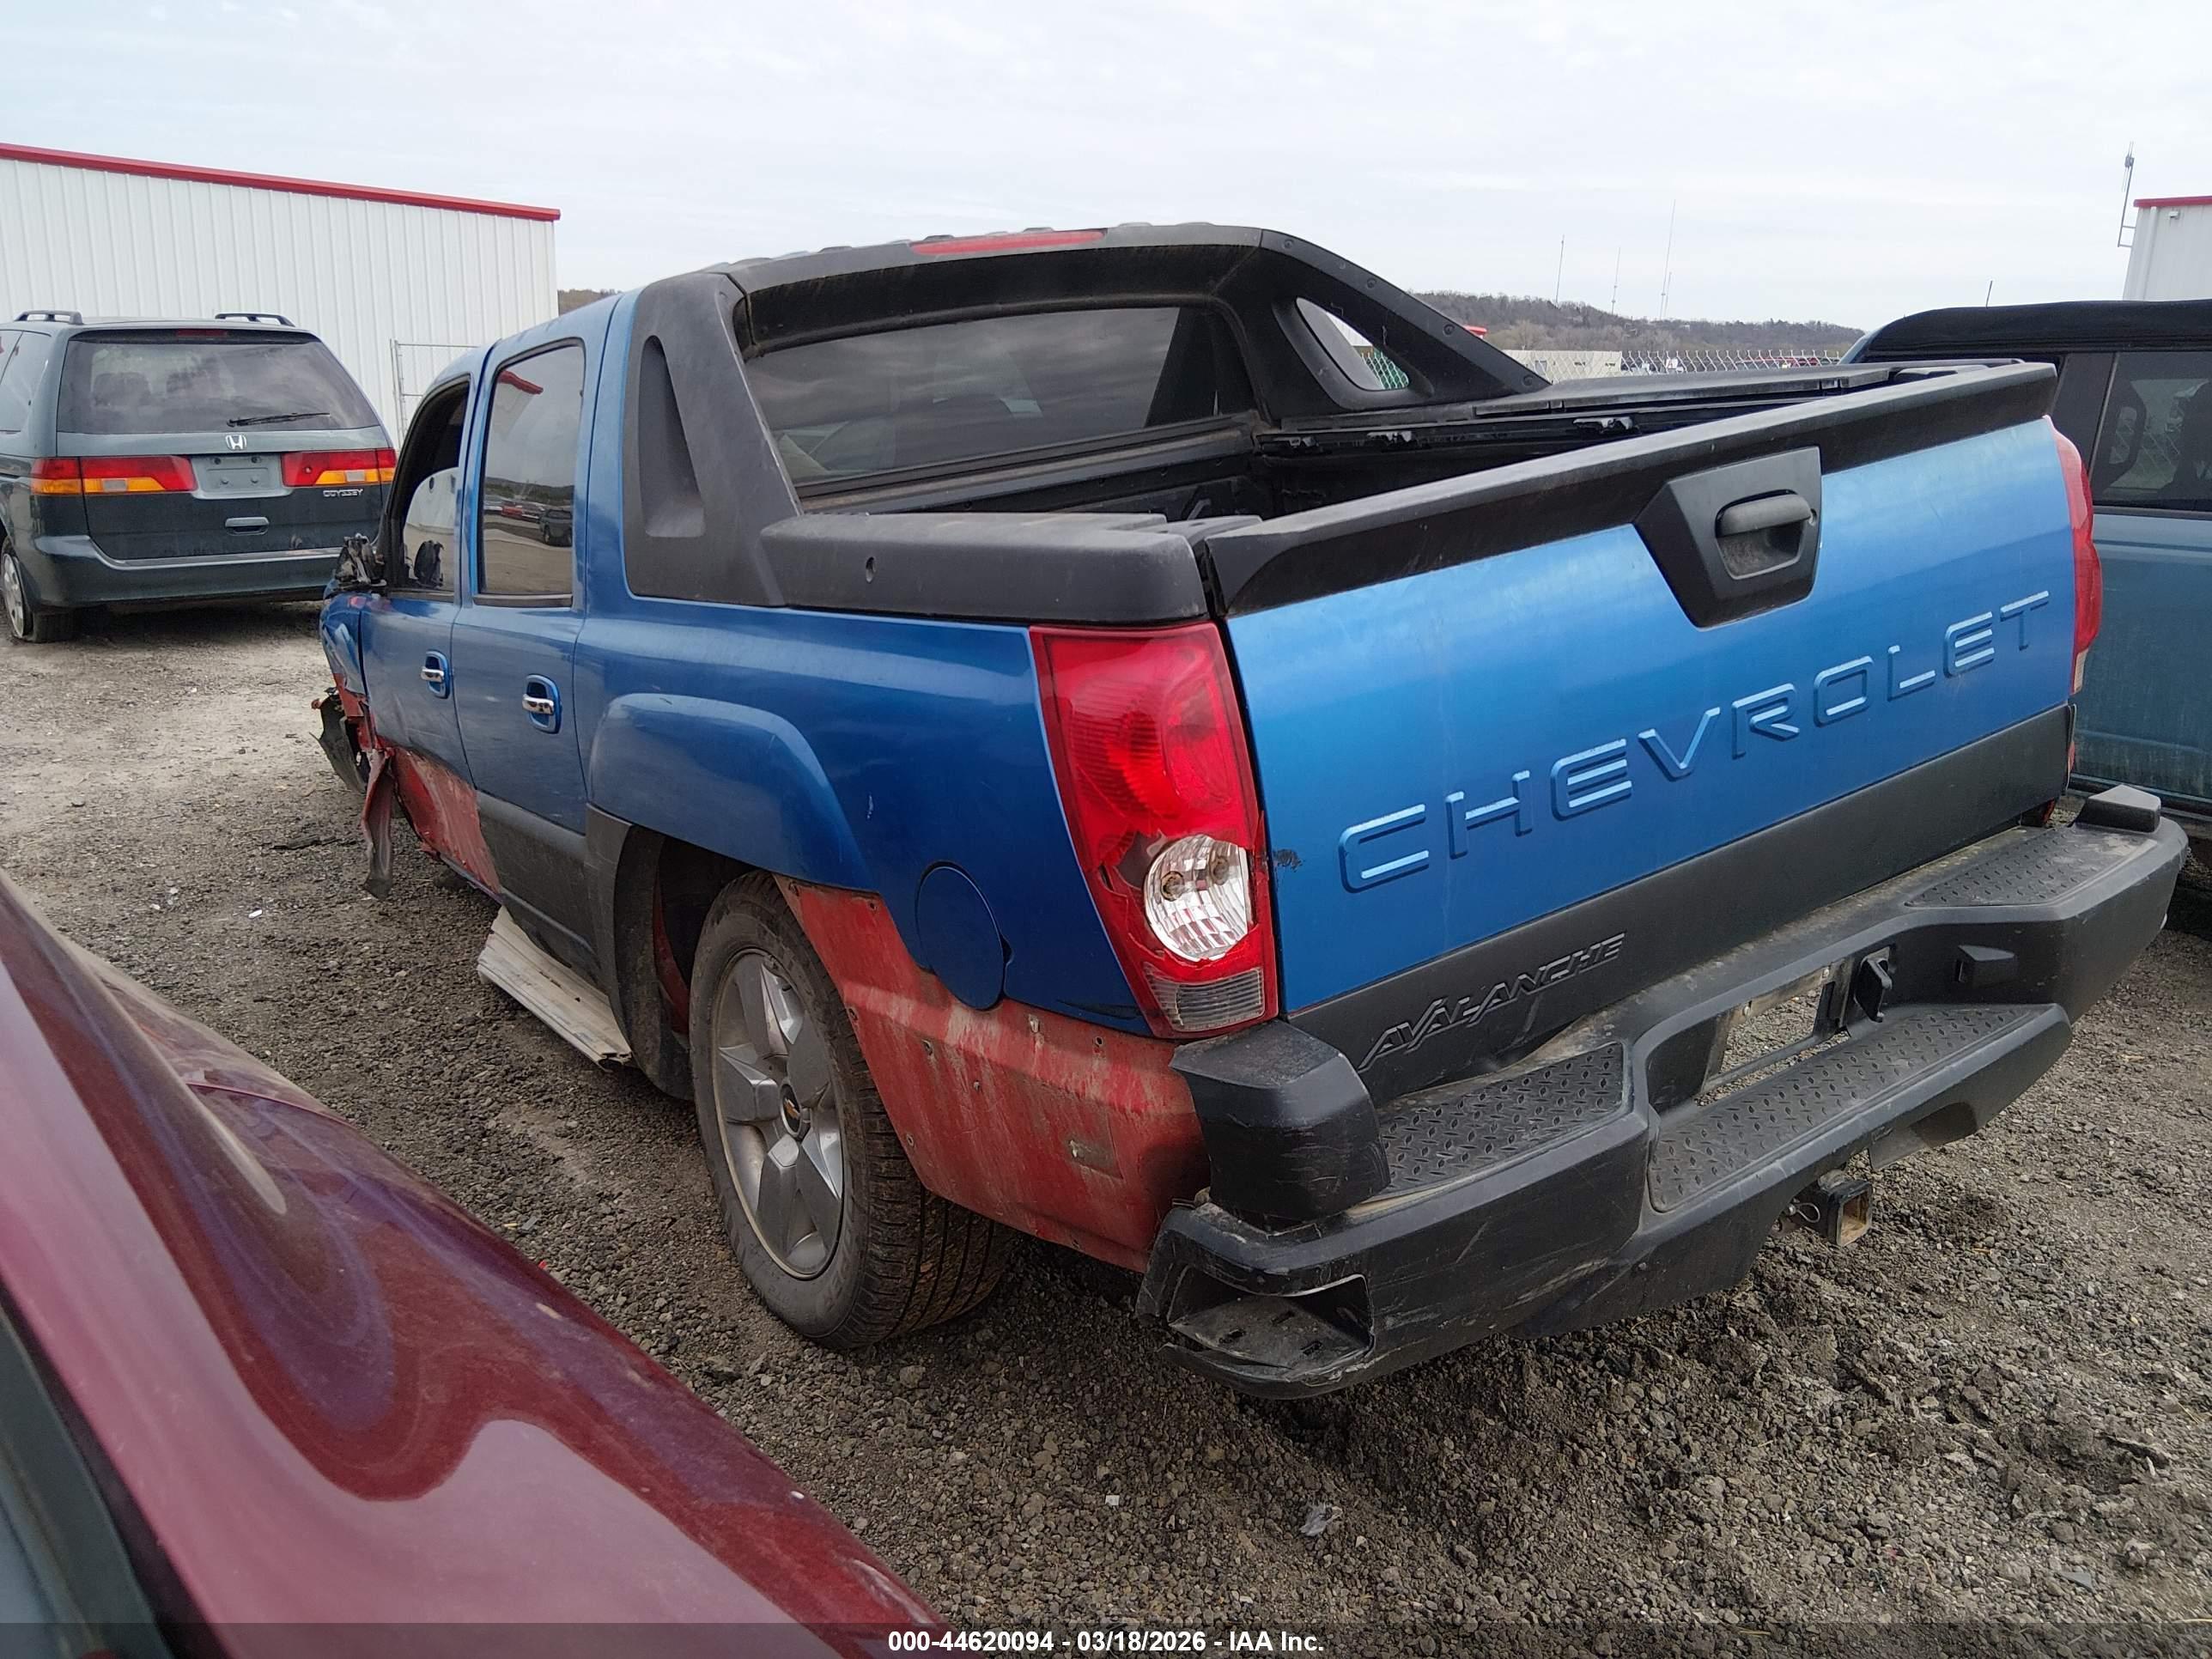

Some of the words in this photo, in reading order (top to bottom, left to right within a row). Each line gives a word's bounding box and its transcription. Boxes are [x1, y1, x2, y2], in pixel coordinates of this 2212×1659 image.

[322, 488, 364, 498] ODYSSEY
[1338, 590, 2050, 894] CHEVROLET
[1357, 932, 1626, 1074] AVALANCHE
